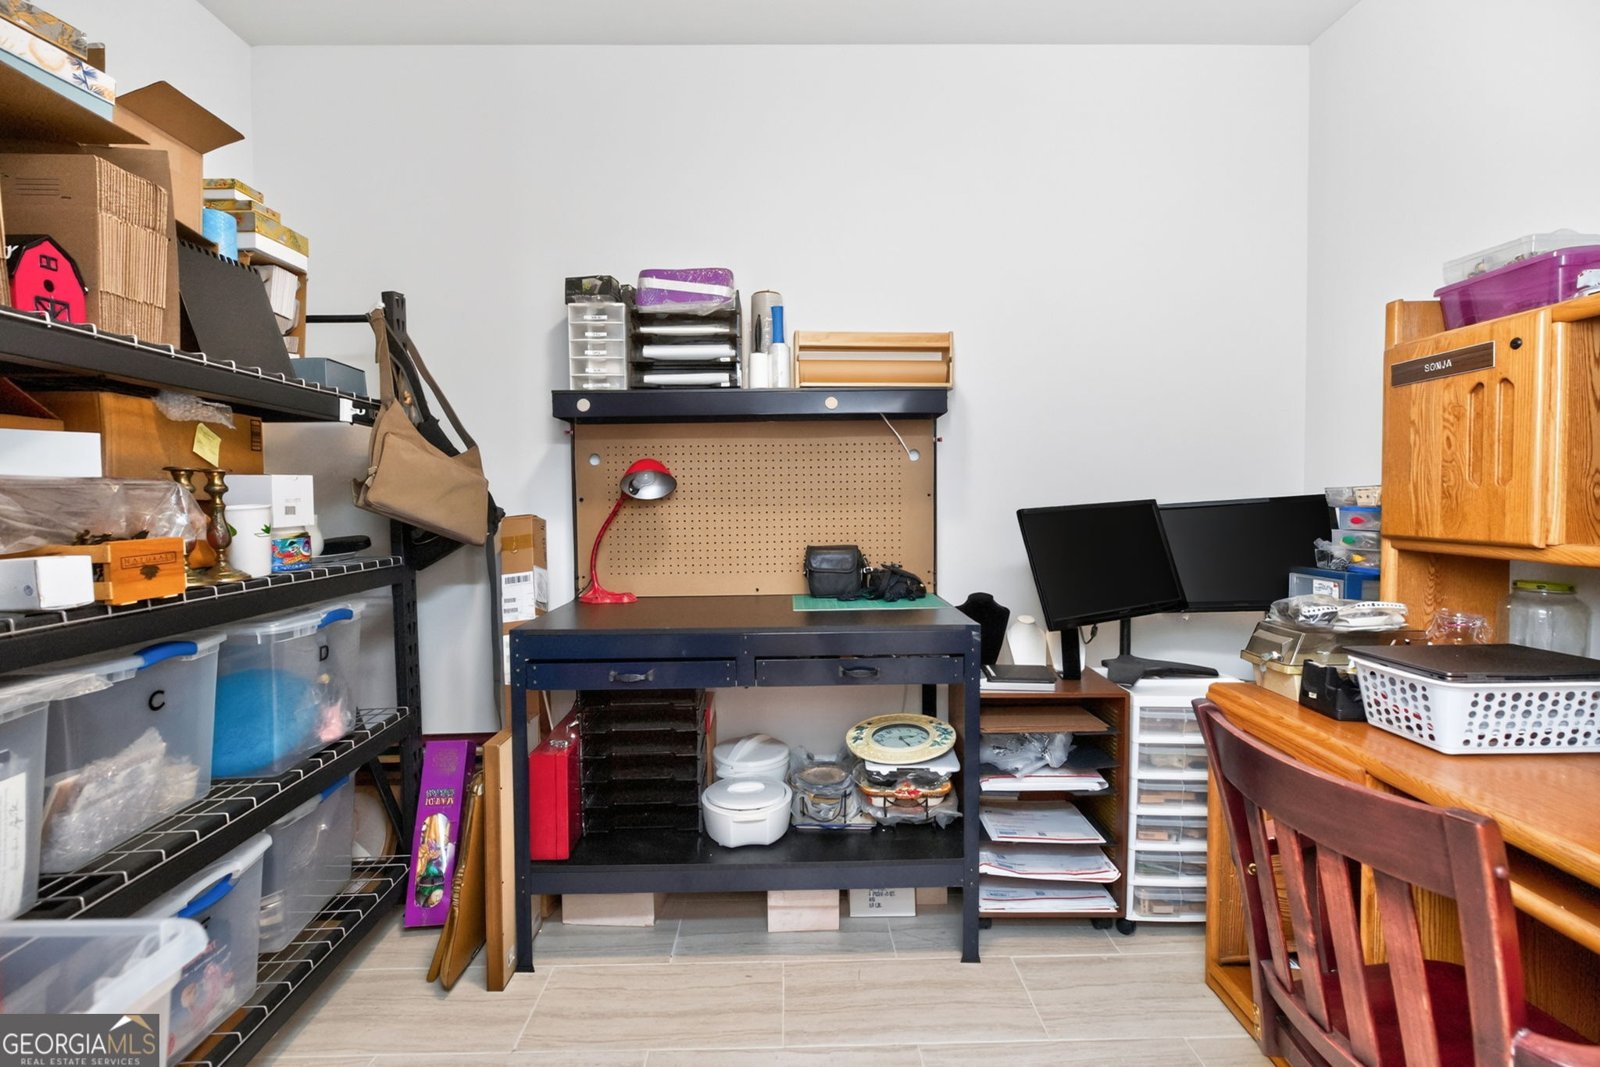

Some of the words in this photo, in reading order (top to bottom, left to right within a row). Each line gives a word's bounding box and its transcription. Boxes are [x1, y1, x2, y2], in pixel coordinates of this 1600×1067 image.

[1424, 359, 1452, 372] SONJA
[319, 645, 329, 661] D
[148, 690, 165, 711] C
